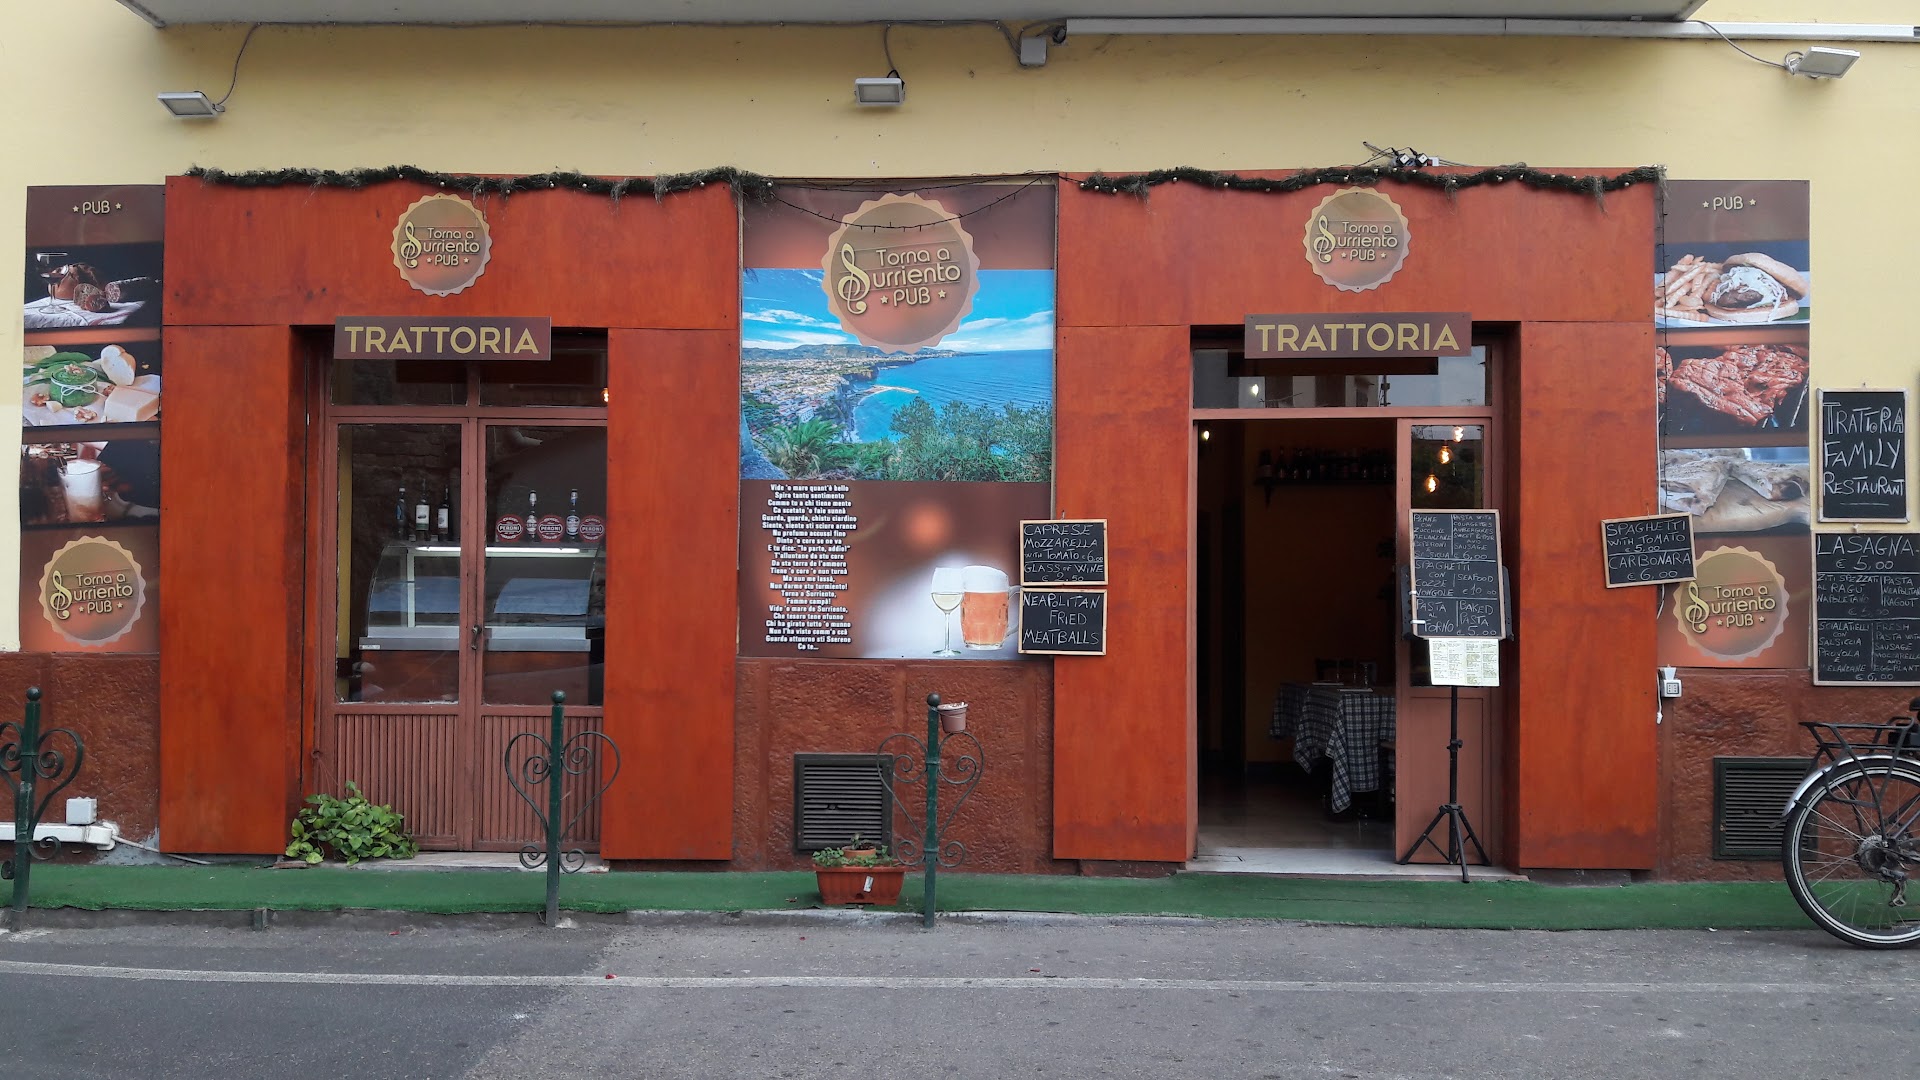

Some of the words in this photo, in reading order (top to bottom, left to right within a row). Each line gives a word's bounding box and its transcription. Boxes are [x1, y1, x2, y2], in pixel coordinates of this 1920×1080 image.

[82, 200, 110, 214] PUB
[1713, 196, 1744, 210] PUB
[427, 228, 461, 240] Torna
[465, 230, 474, 240] a
[1342, 221, 1378, 234] Torna
[1382, 224, 1392, 234] a
[434, 254, 459, 266] PUB
[875, 249, 930, 266] Torna
[936, 248, 950, 261] a
[1349, 249, 1376, 261] PUB
[893, 286, 931, 306] PUB
[344, 326, 539, 354] TRATTORIA
[1255, 323, 1460, 351] TRATTORIA
[1823, 402, 1903, 434] TRATTORIA
[1824, 438, 1900, 469] FAMILY
[1824, 471, 1905, 496] RESTAURANT
[1024, 525, 1093, 536] CAPRESE
[1607, 520, 1685, 536] SPAGHETTI
[1024, 538, 1097, 548] MOZZARELLA
[1608, 537, 1633, 546] WITH
[1638, 532, 1685, 544] TOMATO
[1817, 536, 1914, 557] LASAGNA
[1043, 548, 1079, 560] TOMATO
[1609, 551, 1691, 569] CARBONARA
[1024, 564, 1060, 573] GLASS
[1075, 564, 1103, 573] WINE
[1416, 560, 1470, 571] SPAGHETTI
[1836, 559, 1846, 568] €
[1854, 556, 1893, 570] 5,00
[76, 574, 112, 586] Torna
[116, 573, 126, 583] a
[1416, 579, 1447, 587] COZZE
[1458, 573, 1493, 582] SEAFOOD
[1884, 576, 1913, 586] PASTA
[1416, 588, 1453, 596] VONGOLE
[1713, 586, 1753, 599] Torna
[1758, 585, 1768, 595] a
[87, 600, 112, 613] PUB
[1023, 593, 1100, 609] NEAPOLITAN
[1417, 599, 1446, 612] PASTA
[1460, 600, 1493, 615] BAKED
[1884, 597, 1918, 607] RAGOUT
[1050, 610, 1087, 625] FRIED
[1460, 612, 1488, 626] PASTA
[1726, 613, 1754, 627] PUB
[1425, 619, 1453, 632] FORNO
[1023, 629, 1099, 644] MEATBALLS
[1819, 638, 1861, 646] SALSICCIA
[1876, 631, 1901, 640] PASTA
[1875, 643, 1912, 651] SAUSAGE
